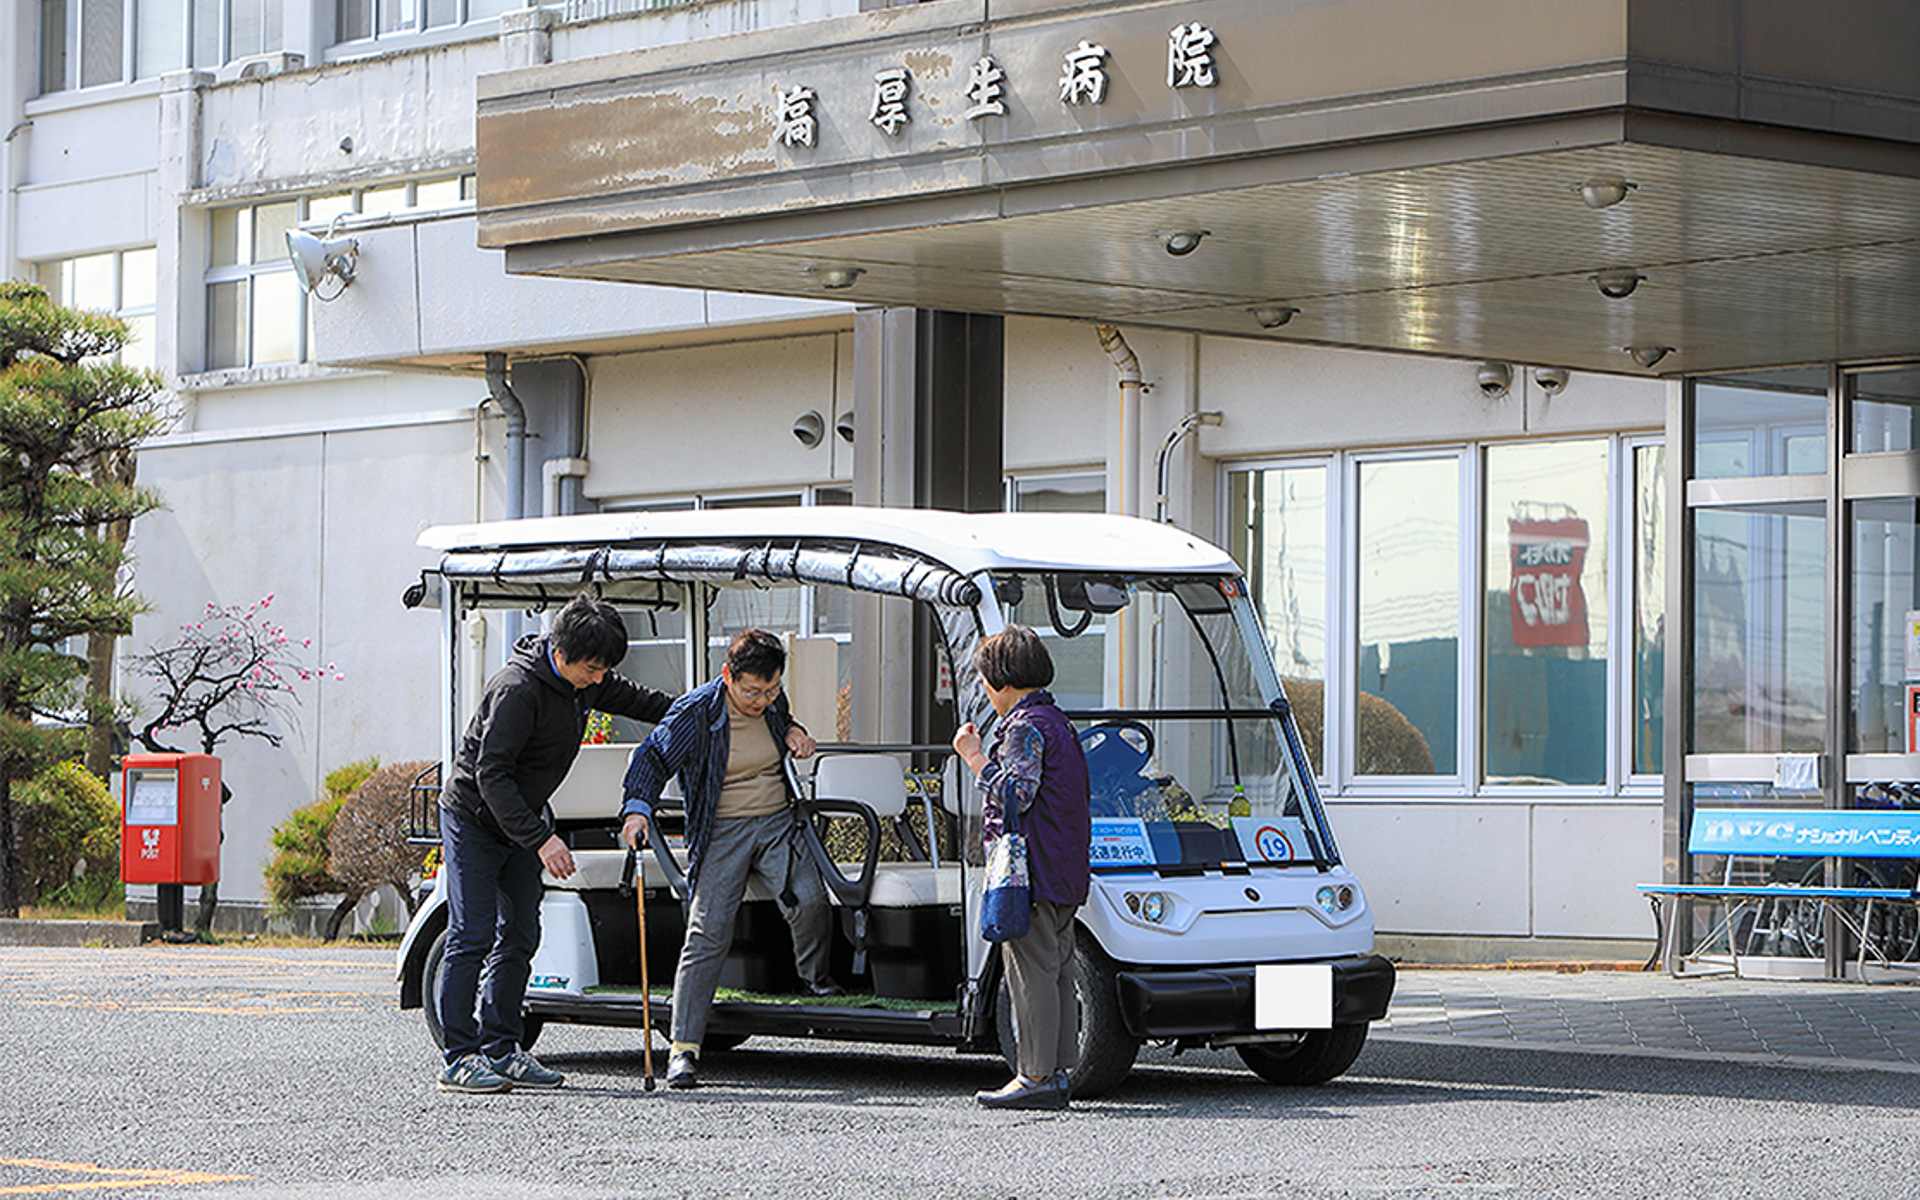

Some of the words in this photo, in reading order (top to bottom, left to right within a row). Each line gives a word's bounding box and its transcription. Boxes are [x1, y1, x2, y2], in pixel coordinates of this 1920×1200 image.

[772, 22, 1220, 149] 塙厚生病院
[1262, 837, 1286, 858] 19
